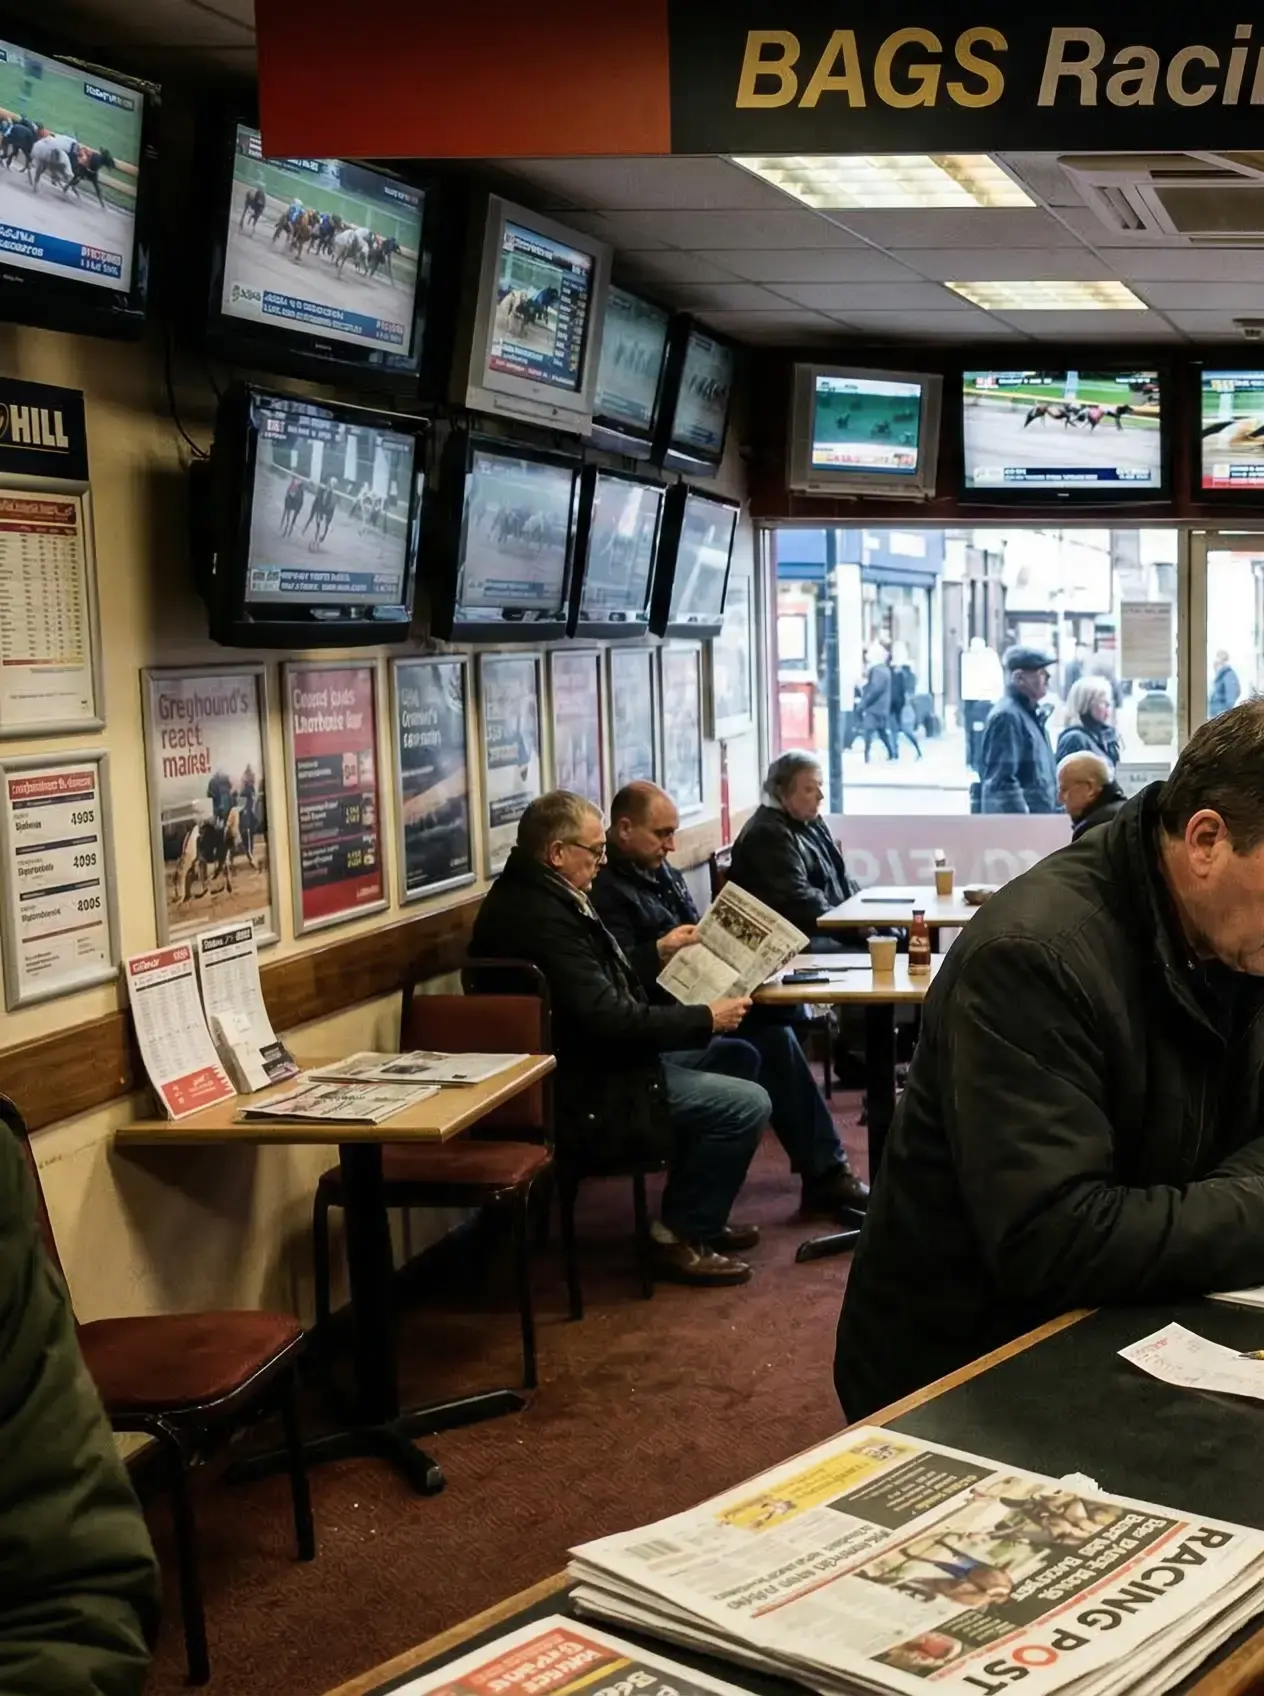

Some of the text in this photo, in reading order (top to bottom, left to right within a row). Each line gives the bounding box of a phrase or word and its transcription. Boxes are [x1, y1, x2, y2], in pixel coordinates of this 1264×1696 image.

[735, 26, 1009, 109] BAGS
[9, 403, 69, 449] HILL
[158, 684, 249, 724] Greyhound's
[1077, 1526, 1234, 1632] RACING
[962, 1627, 1092, 1696] POST
